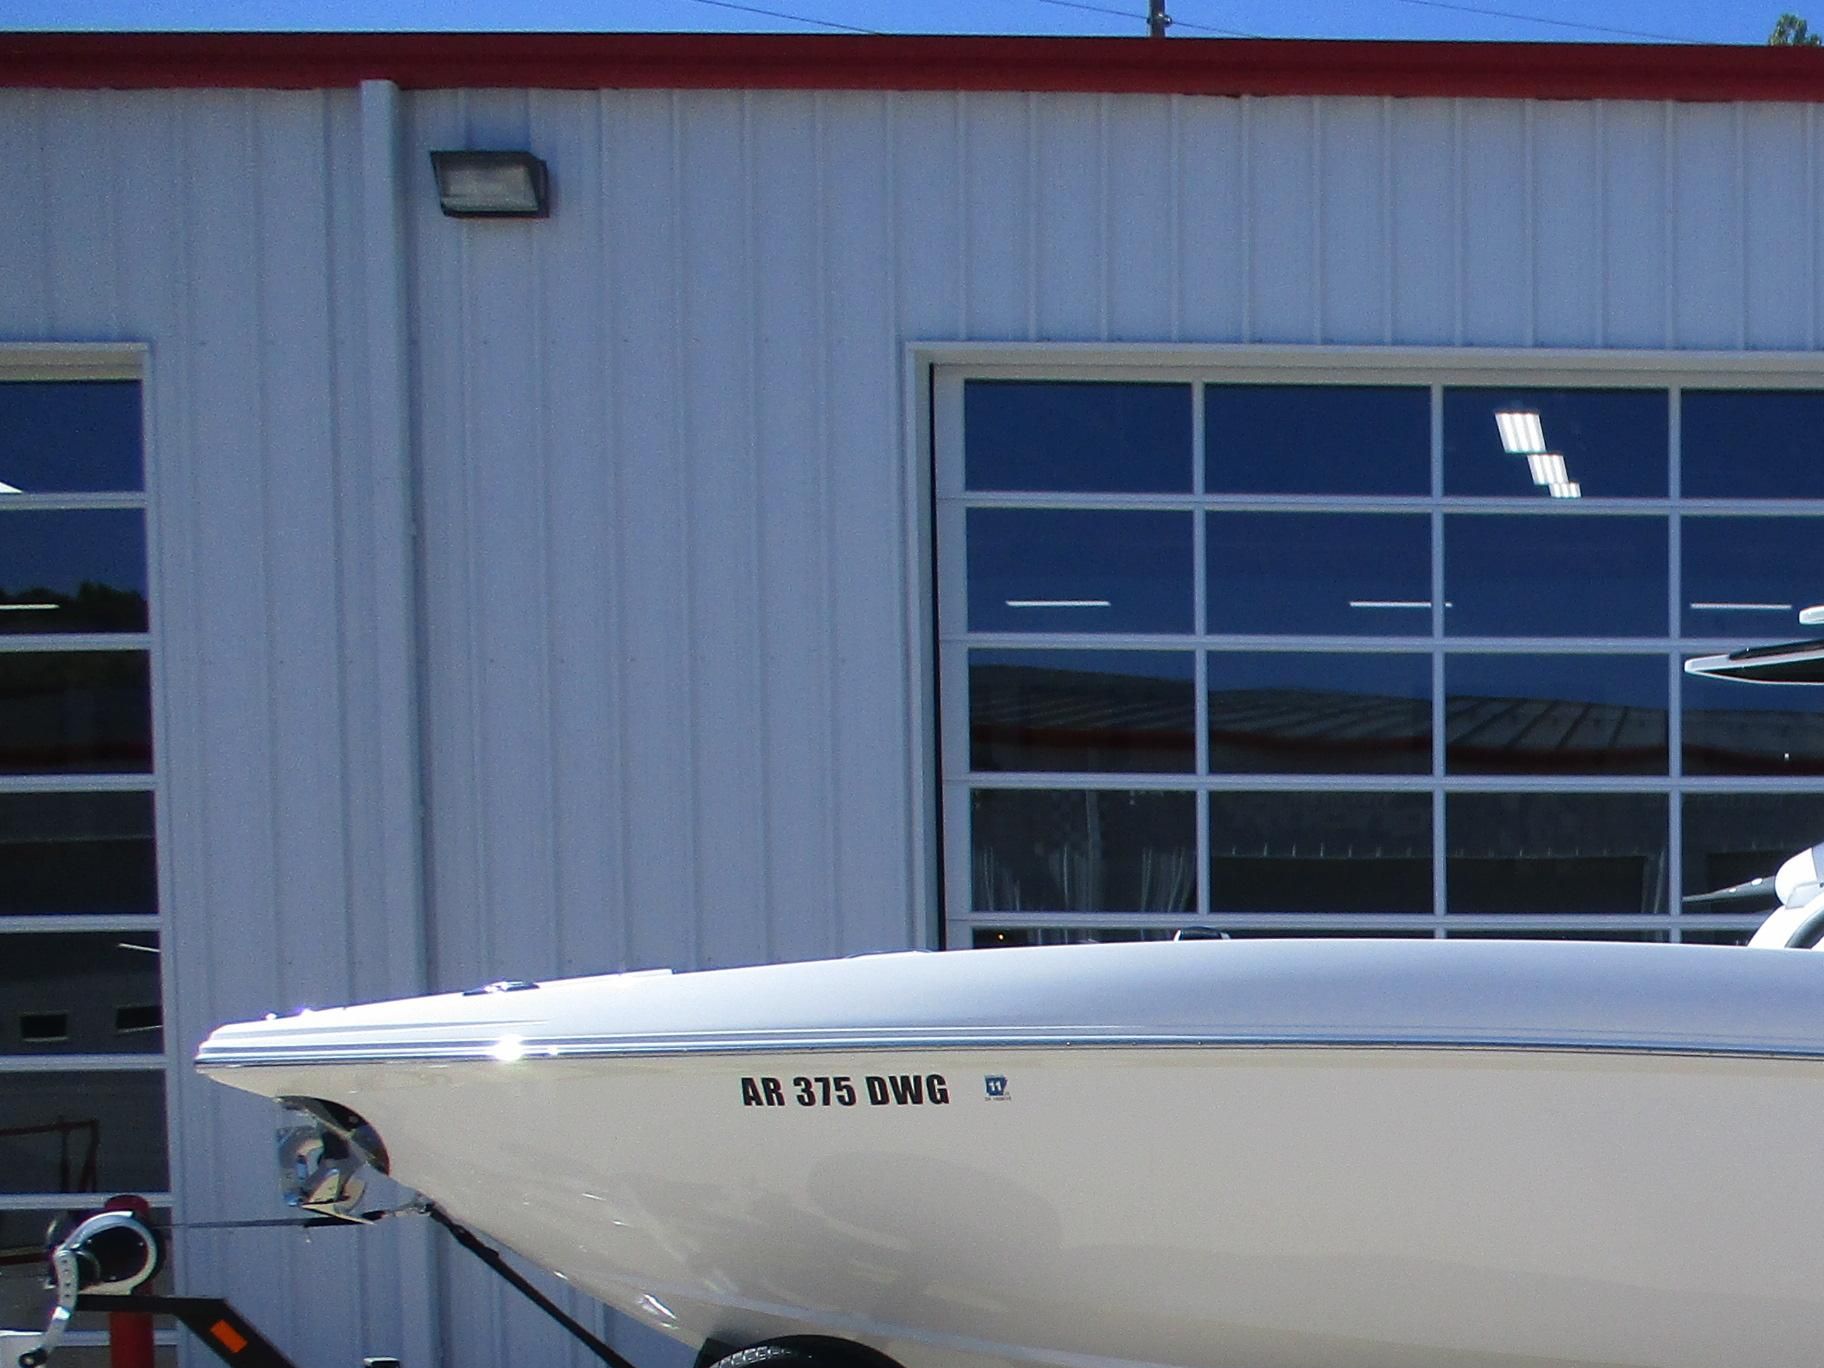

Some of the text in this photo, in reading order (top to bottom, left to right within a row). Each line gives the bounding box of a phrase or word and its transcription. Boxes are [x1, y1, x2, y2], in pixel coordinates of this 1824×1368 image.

[741, 1073, 950, 1107] AR 375 DWG
